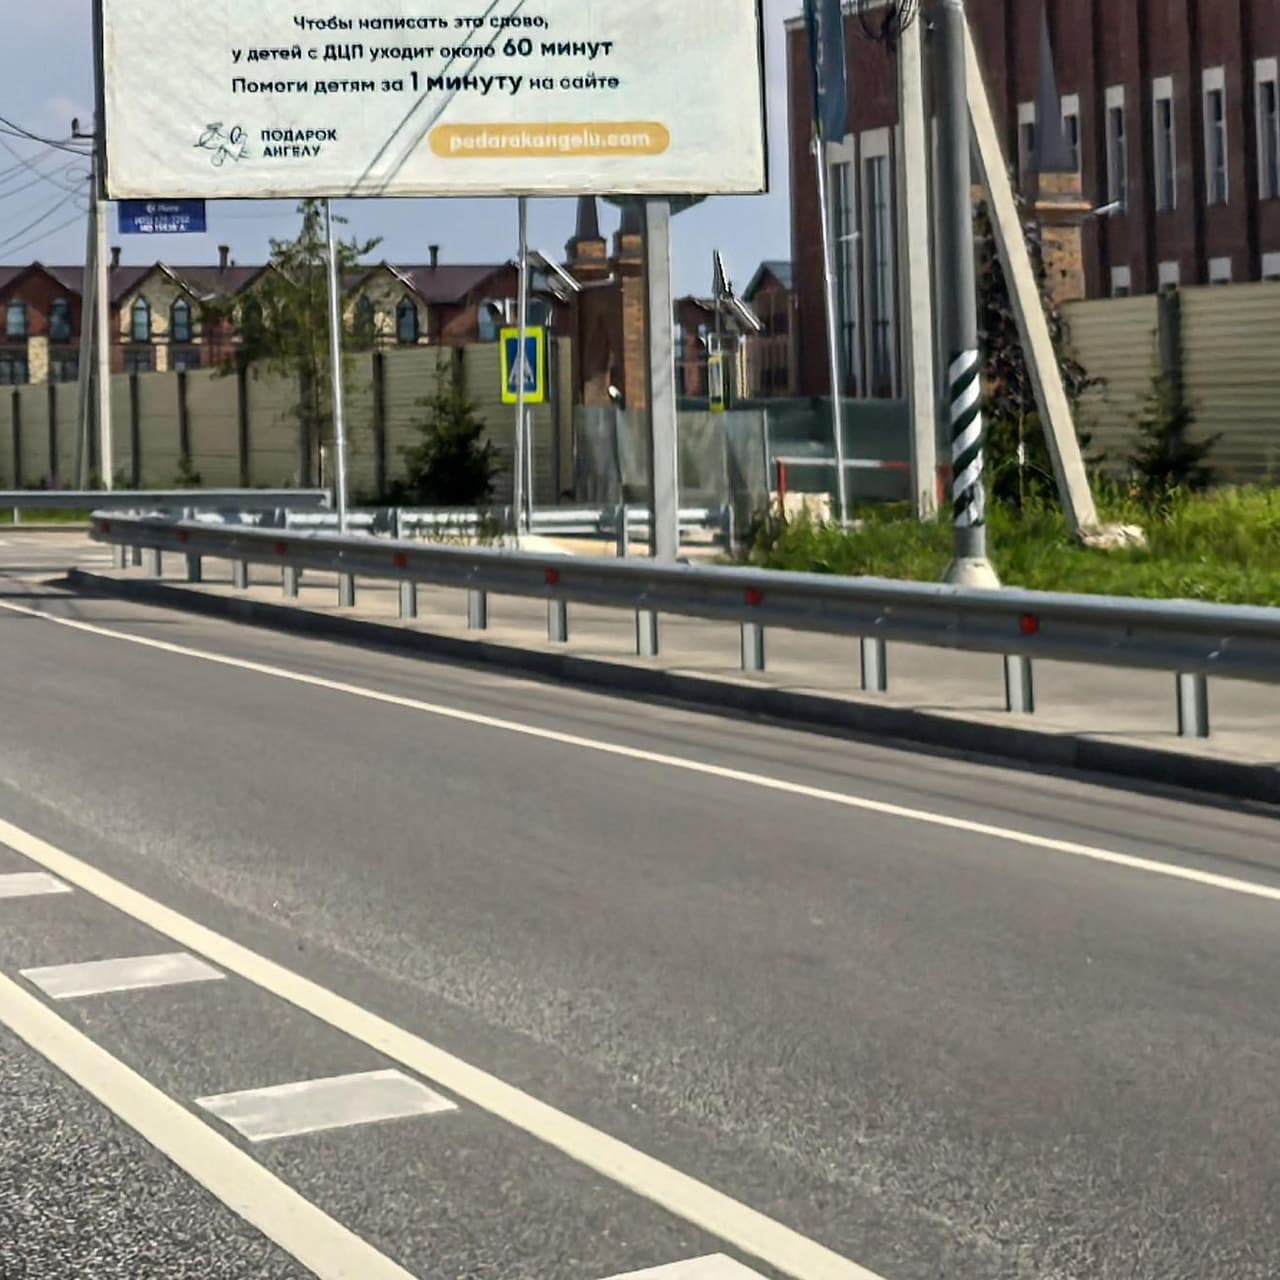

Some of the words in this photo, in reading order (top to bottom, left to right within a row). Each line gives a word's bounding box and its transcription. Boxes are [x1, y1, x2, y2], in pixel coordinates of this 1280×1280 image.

[293, 16, 353, 30] Чтобы
[358, 16, 448, 30] написать
[453, 15, 484, 29] это
[489, 15, 550, 29] слово,
[232, 48, 241, 63] у
[247, 44, 302, 62] детей
[307, 49, 318, 60] с
[323, 44, 364, 62] ДЦП
[369, 45, 435, 62] уходит
[440, 46, 496, 59] около
[502, 38, 533, 57] 60
[540, 40, 614, 60] минут
[232, 78, 309, 94] Помоги
[313, 79, 376, 95] детям
[381, 79, 404, 92] за
[410, 71, 419, 92] 1
[426, 74, 523, 96] минуту
[529, 77, 554, 90] на
[559, 72, 621, 90] сайте
[260, 129, 338, 143] ПОДАРОК
[263, 145, 321, 158] АНГЕЛУ
